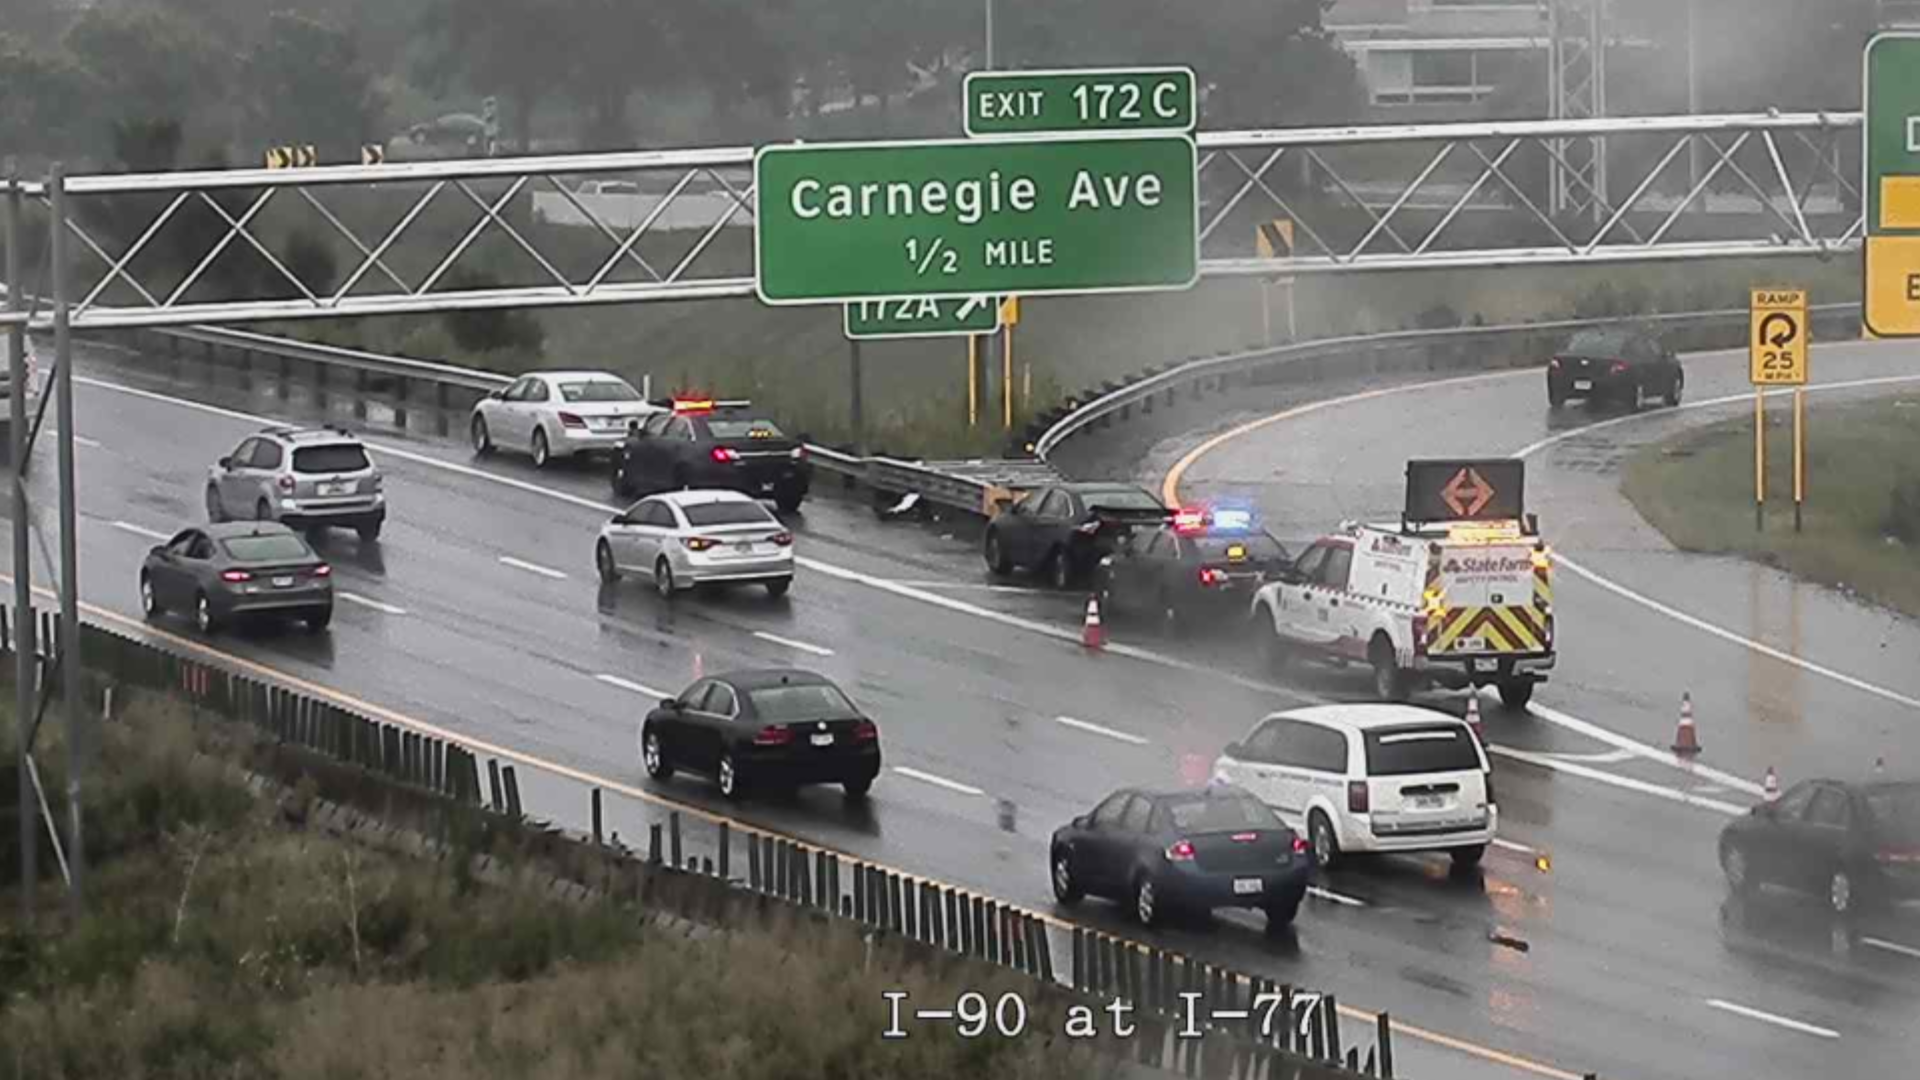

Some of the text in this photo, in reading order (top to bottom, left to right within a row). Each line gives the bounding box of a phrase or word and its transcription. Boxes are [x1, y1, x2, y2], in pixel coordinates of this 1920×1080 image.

[979, 92, 1044, 118] EXIT
[791, 171, 1163, 224] Carnegie Ave
[985, 239, 1054, 266] MILE
[1757, 292, 1800, 305] RAMP
[1763, 351, 1794, 370] 25
